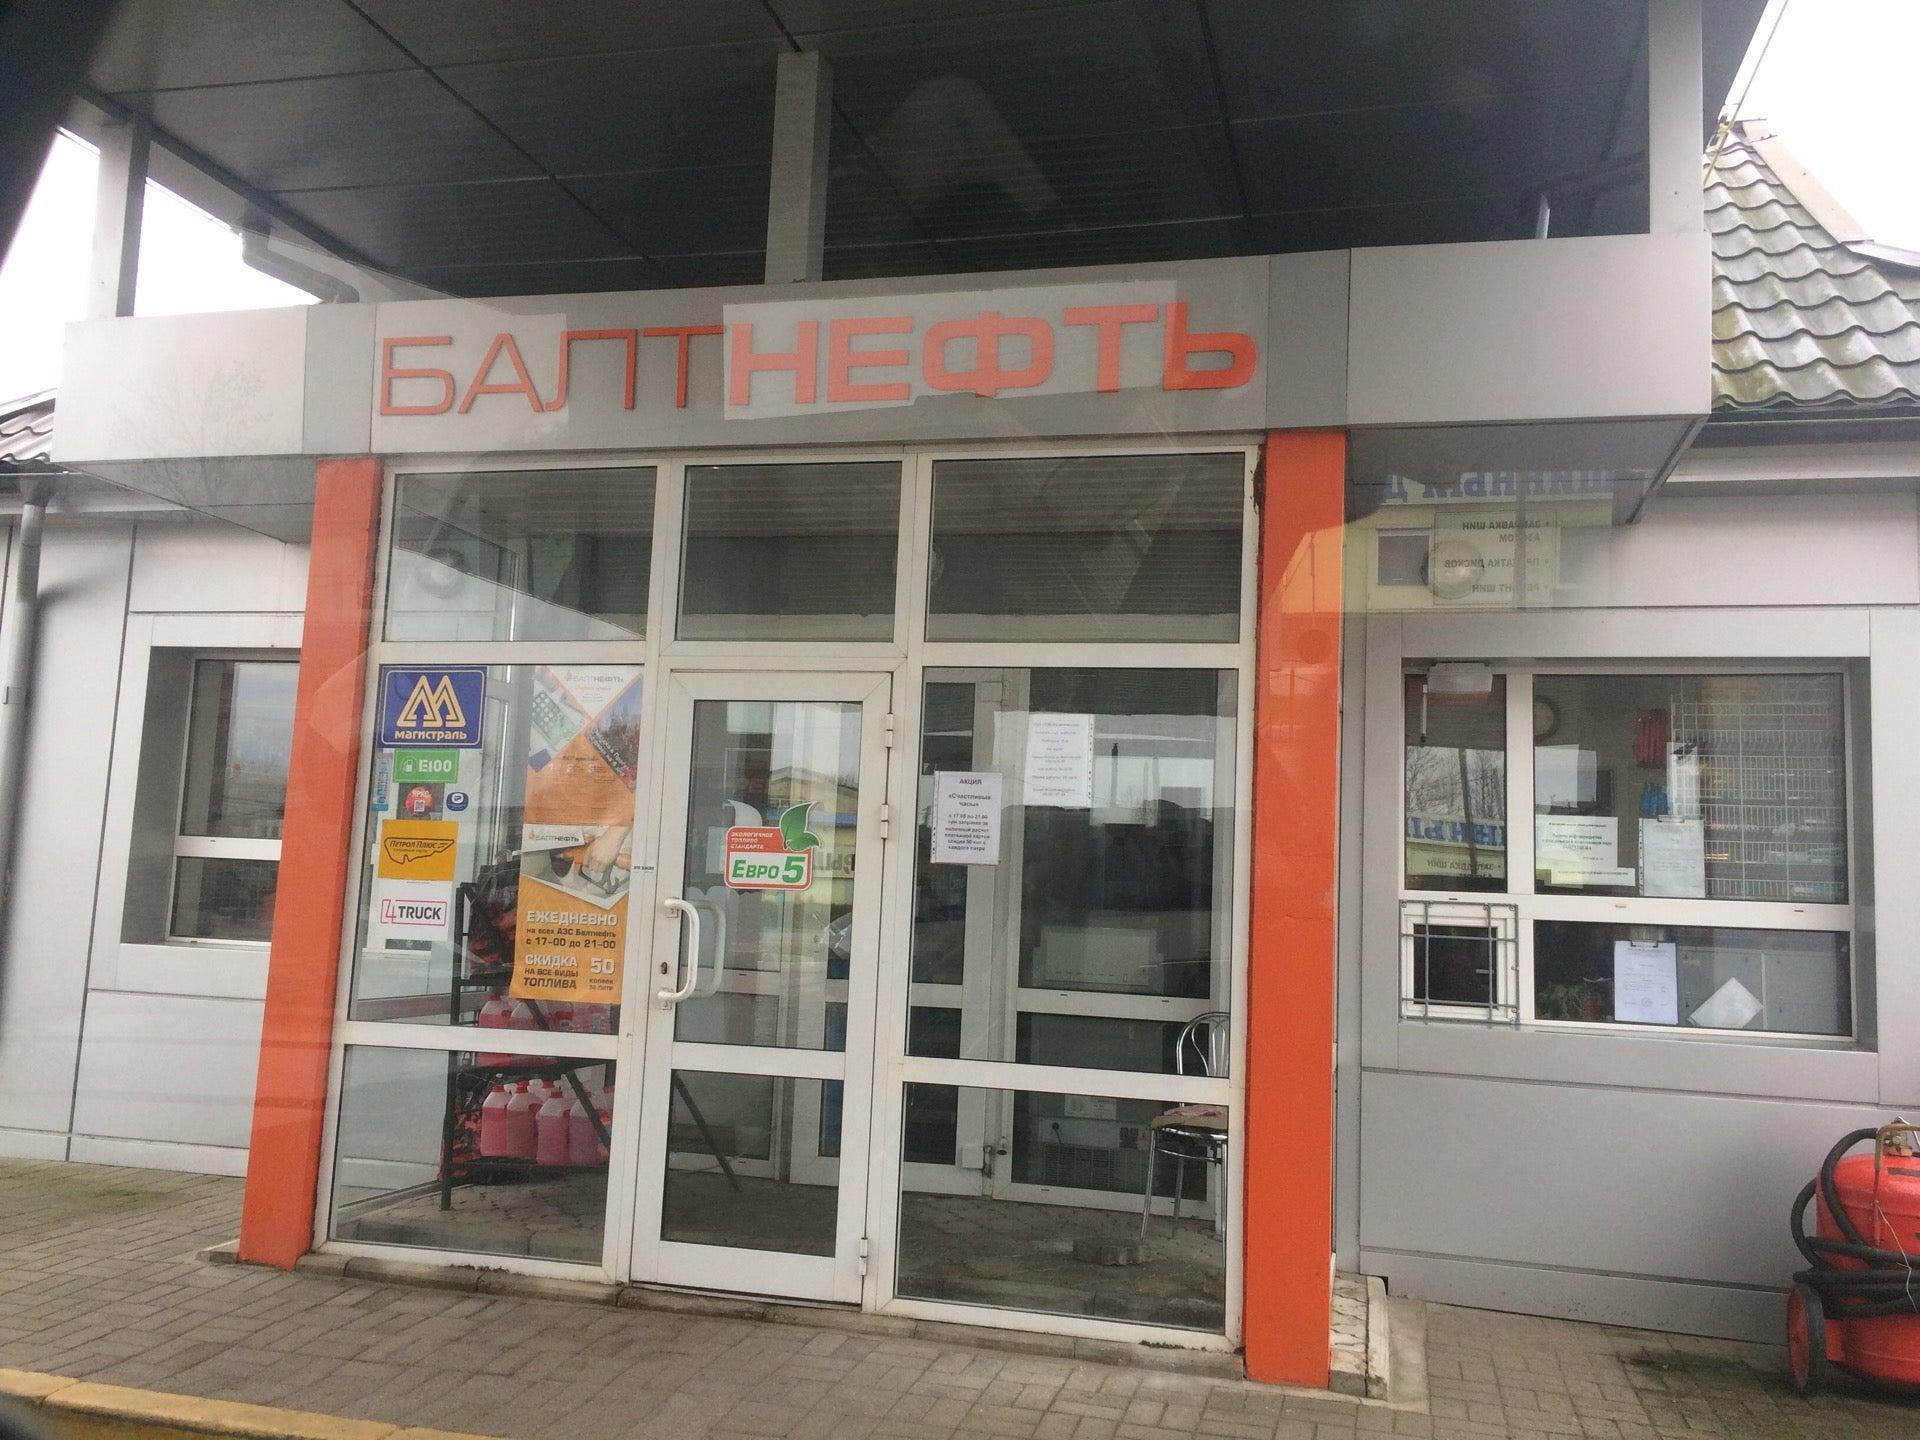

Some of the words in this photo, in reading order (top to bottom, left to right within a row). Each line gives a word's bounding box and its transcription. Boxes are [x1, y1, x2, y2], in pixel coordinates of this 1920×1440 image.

[380, 301, 1257, 416] БАЛТНЕФТЬ
[782, 856, 806, 883] 5
[527, 911, 618, 926] ЕЖЕДНЕВНО
[525, 954, 578, 968] СКИДКА
[591, 957, 615, 975] 50
[537, 968, 552, 976] ВСЕ
[523, 977, 577, 989] ТОПЛИВА
